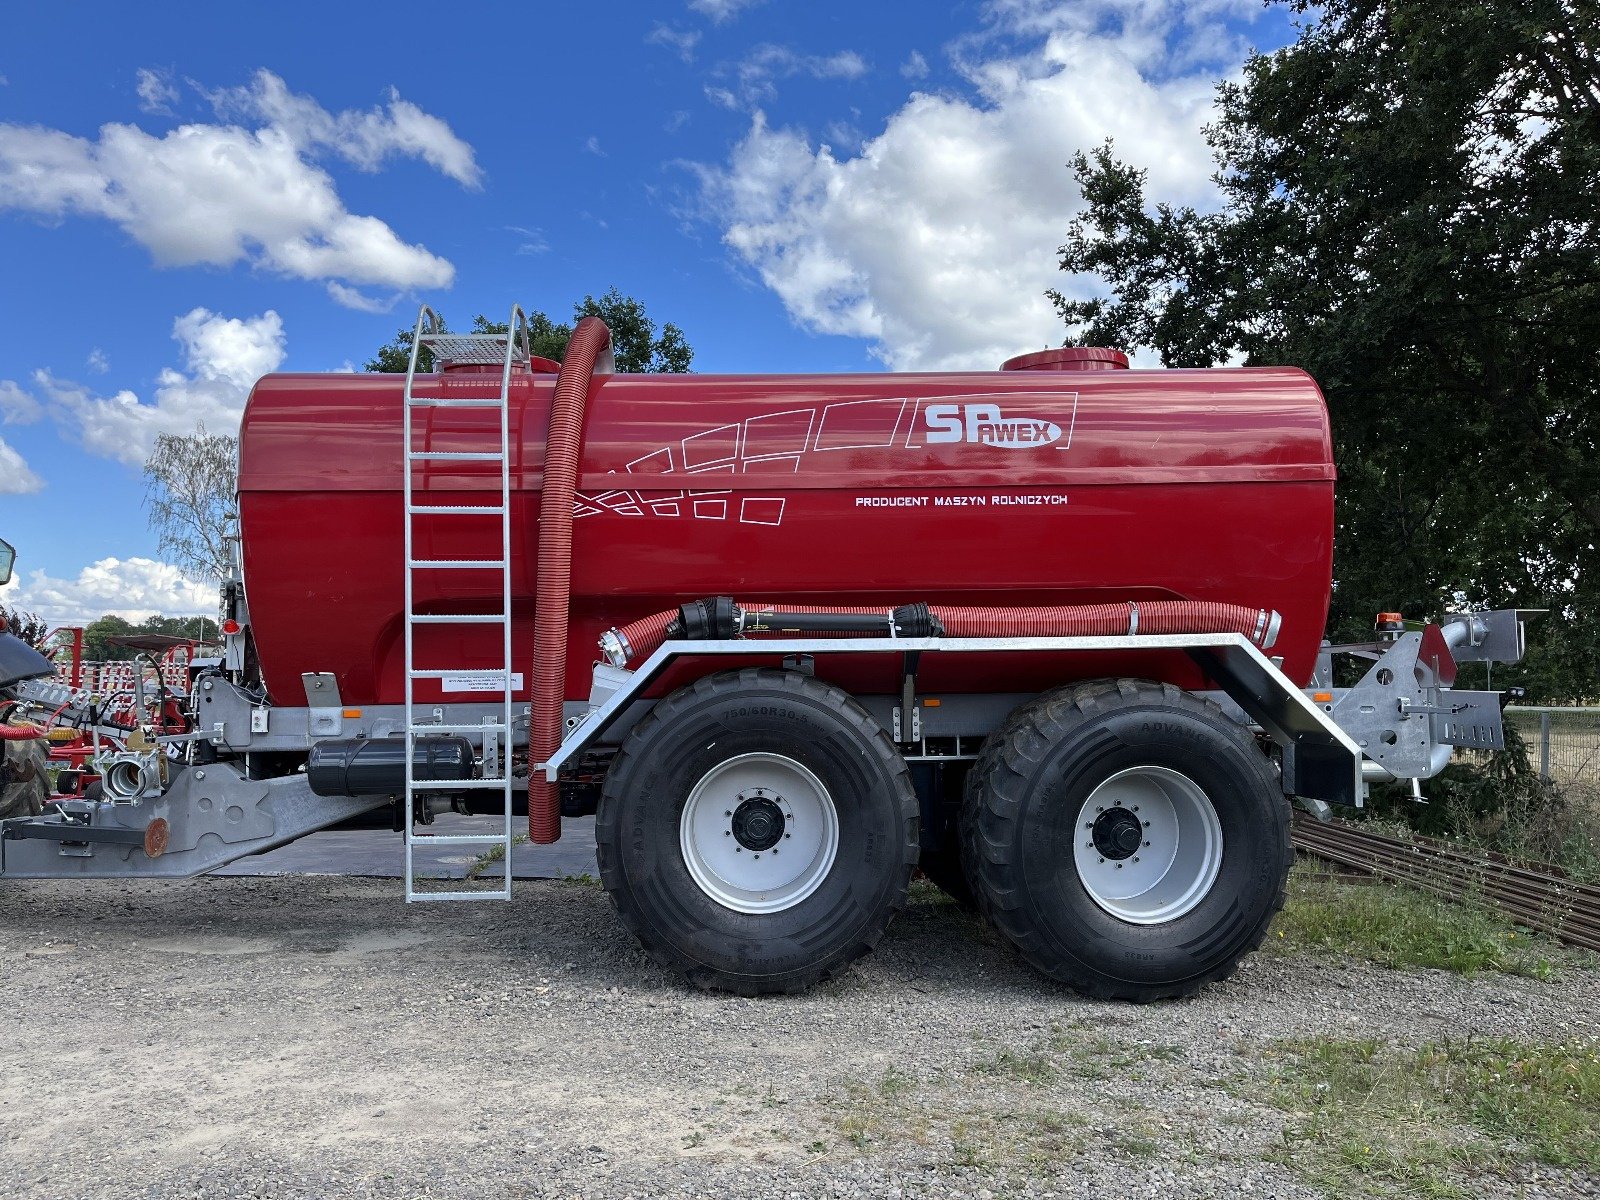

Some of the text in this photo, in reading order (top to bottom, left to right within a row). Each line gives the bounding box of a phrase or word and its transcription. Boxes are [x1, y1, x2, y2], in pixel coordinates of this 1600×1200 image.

[855, 494, 1068, 507] PRODUCENT MASZYN ROLNICZYCH
